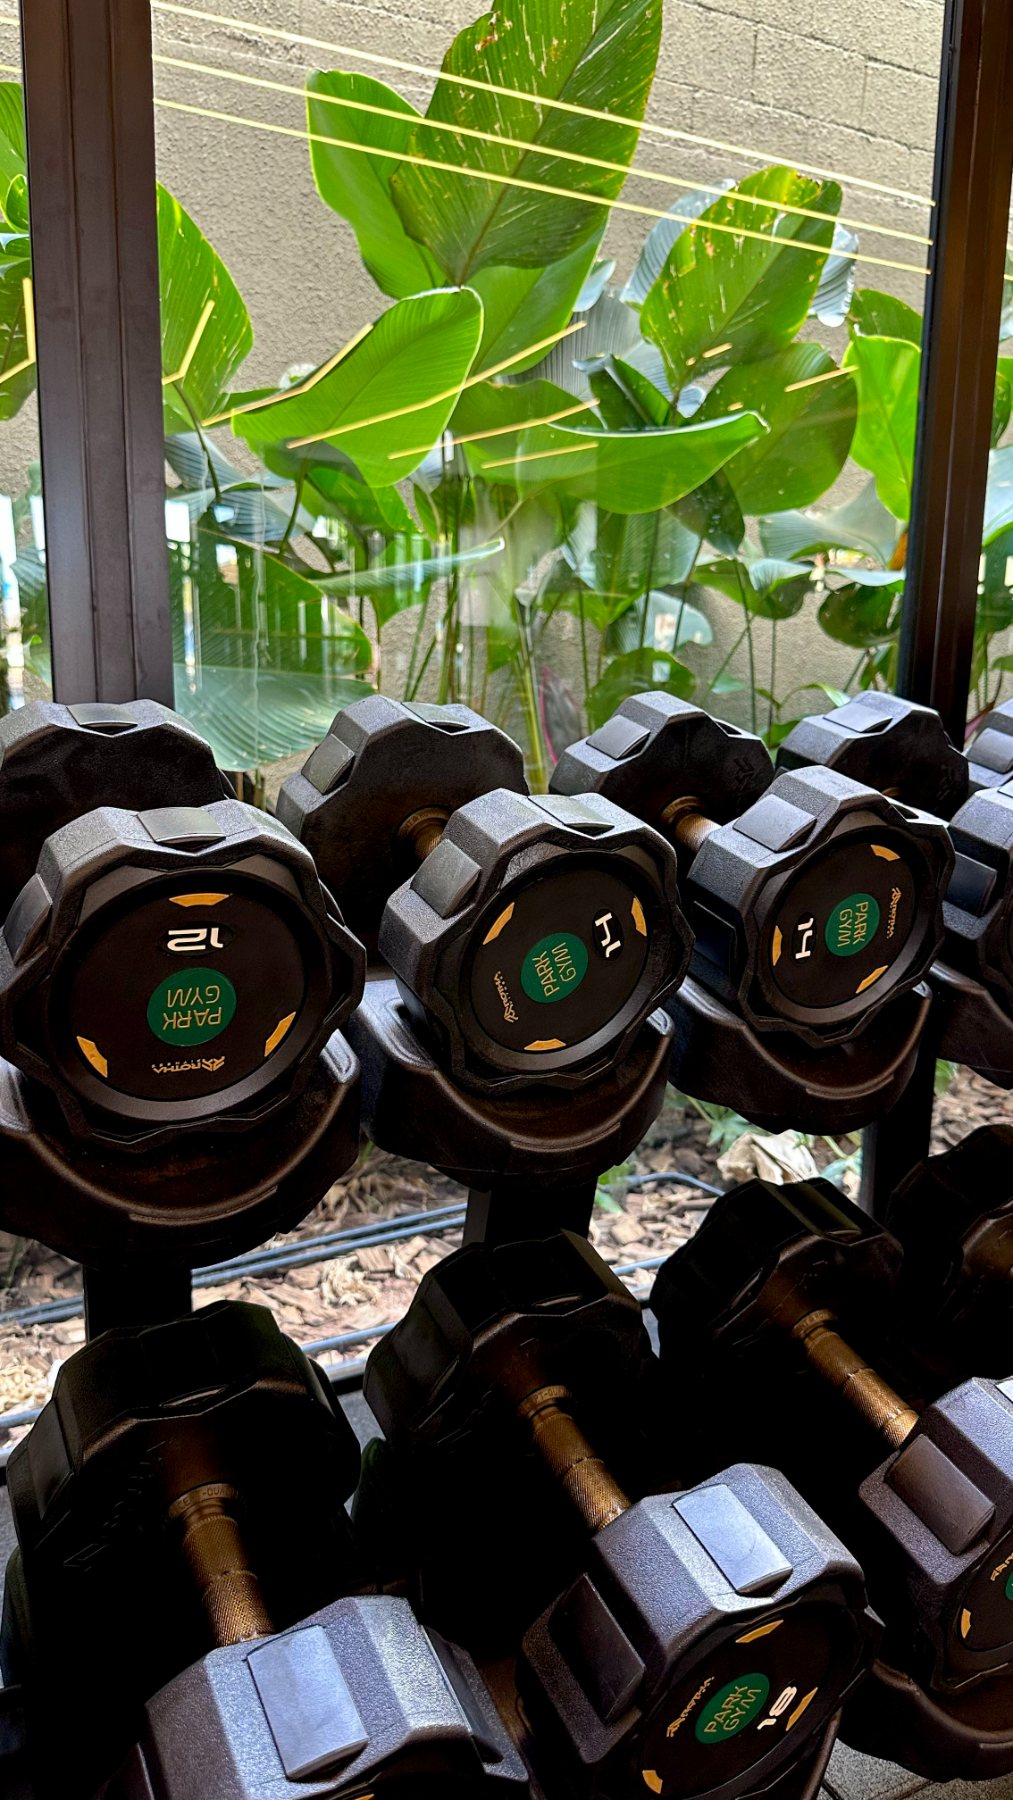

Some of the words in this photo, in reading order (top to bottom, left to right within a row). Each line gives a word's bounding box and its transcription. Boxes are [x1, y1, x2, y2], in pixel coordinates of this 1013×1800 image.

[166, 927, 224, 952] 12
[594, 912, 621, 958] 14
[795, 917, 814, 960] 14
[837, 908, 853, 948] GYM
[852, 901, 869, 945] PARK
[532, 950, 560, 997] PARK
[551, 941, 577, 982] GYM
[166, 985, 221, 1008] GYM
[162, 1006, 222, 1031] PARK
[704, 1685, 749, 1733] PARK
[723, 1688, 762, 1732] GYM
[756, 1686, 798, 1730] 18
